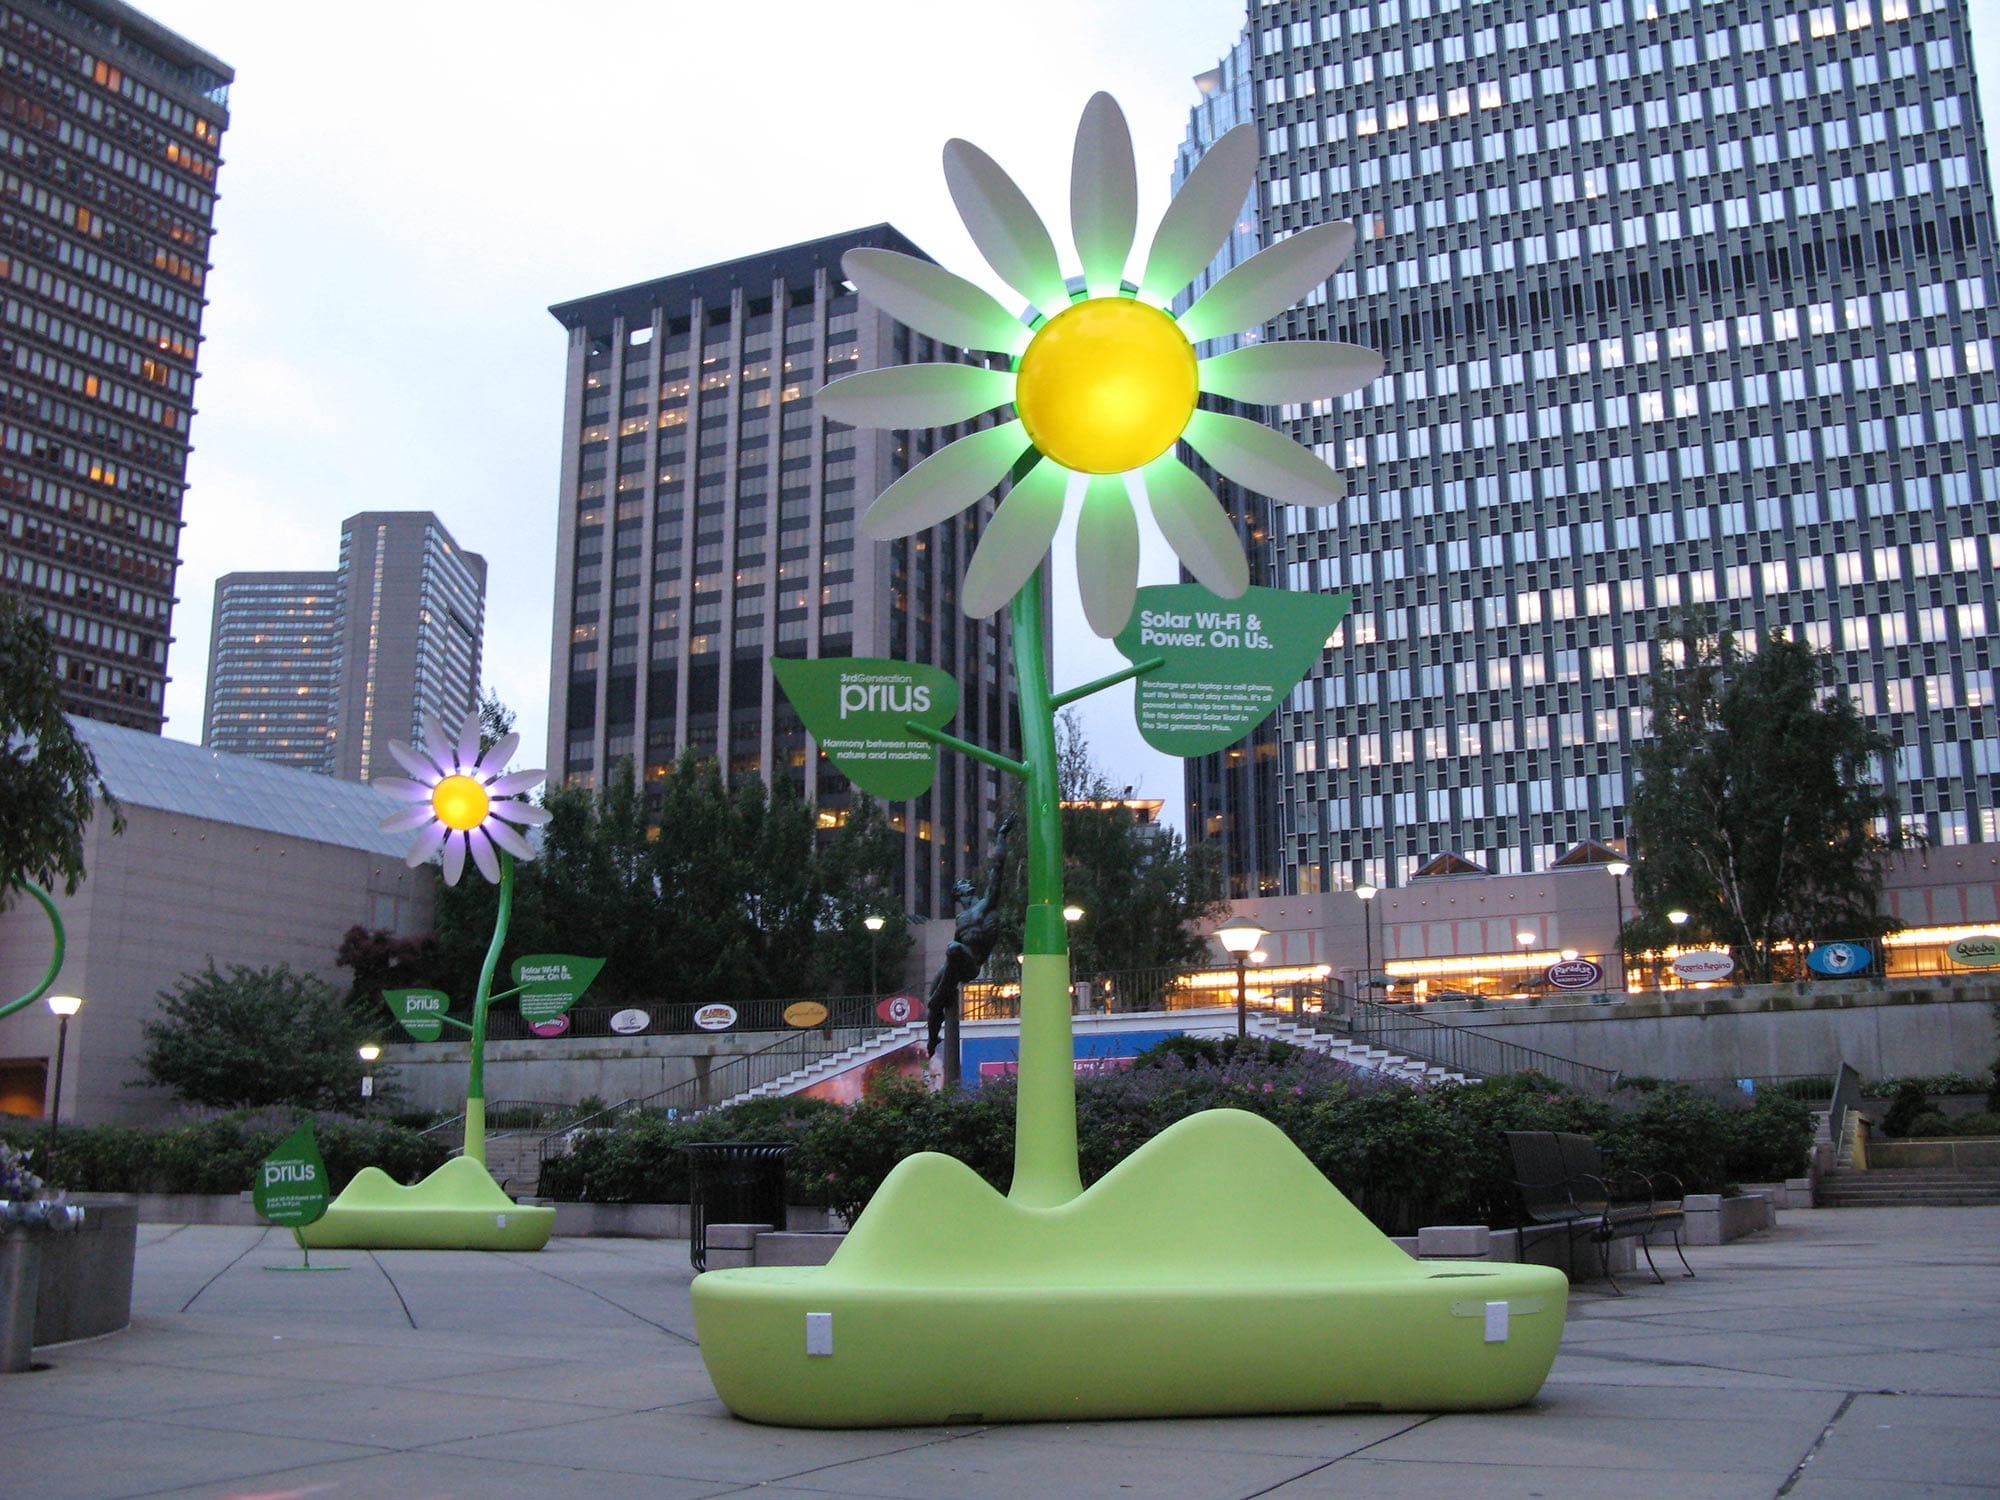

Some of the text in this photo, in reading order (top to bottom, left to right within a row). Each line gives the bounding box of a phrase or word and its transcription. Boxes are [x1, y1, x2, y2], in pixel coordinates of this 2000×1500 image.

[1141, 610, 1262, 630] Solar Wi-Fi &
[1141, 628, 1274, 649] Power. On Us.
[840, 684, 931, 719] prius
[823, 739, 864, 750] Harmony
[867, 751, 887, 760] and
[264, 1163, 316, 1188] prius
